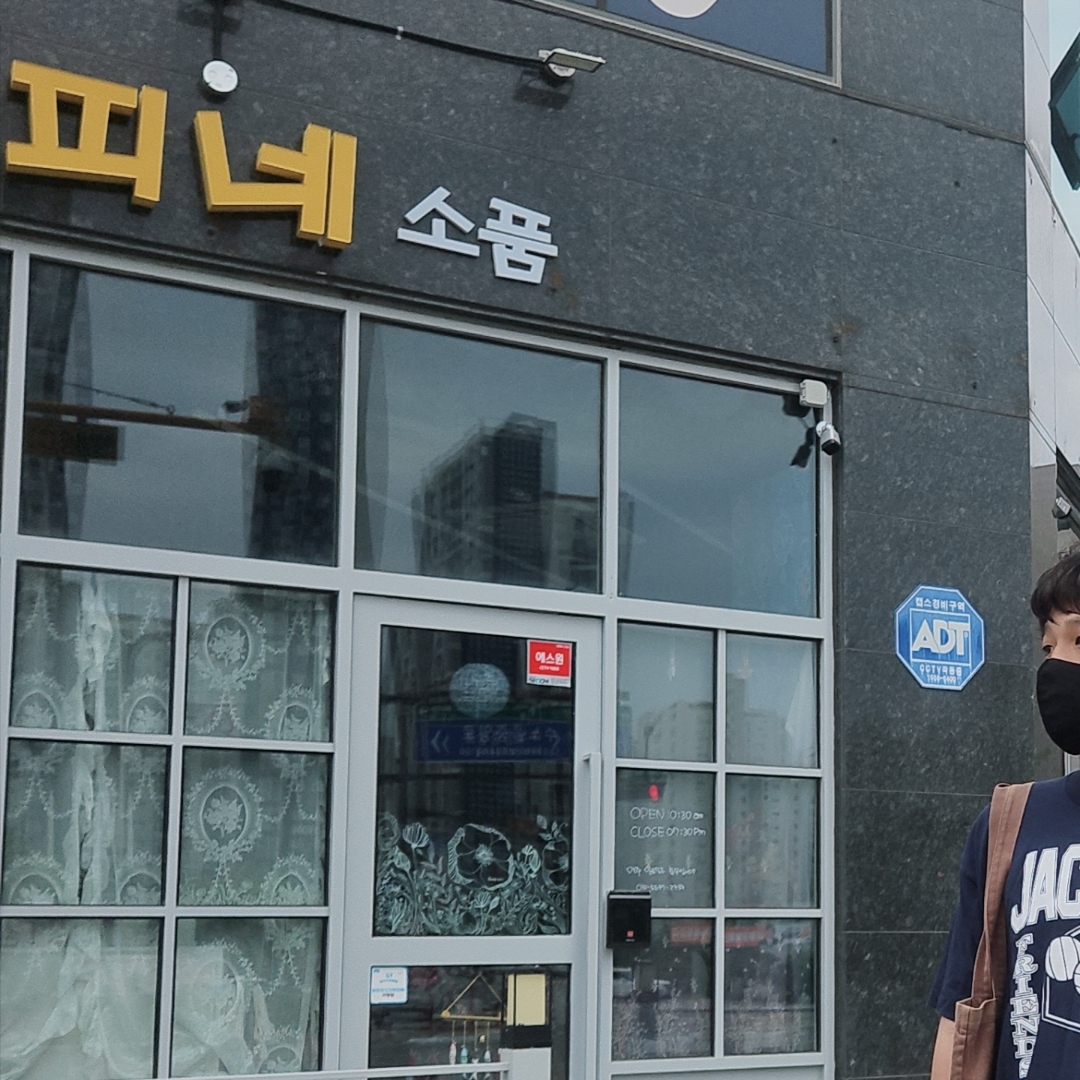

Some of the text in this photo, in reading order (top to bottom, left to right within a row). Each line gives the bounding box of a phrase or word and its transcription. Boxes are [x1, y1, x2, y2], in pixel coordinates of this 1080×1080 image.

[396, 185, 559, 285] 소품
[911, 618, 970, 656] ADT
[535, 651, 564, 666] 에스원
[629, 806, 665, 820] OPEN
[629, 825, 665, 838] CLOSE
[1009, 932, 1041, 1080] FRIENDS
